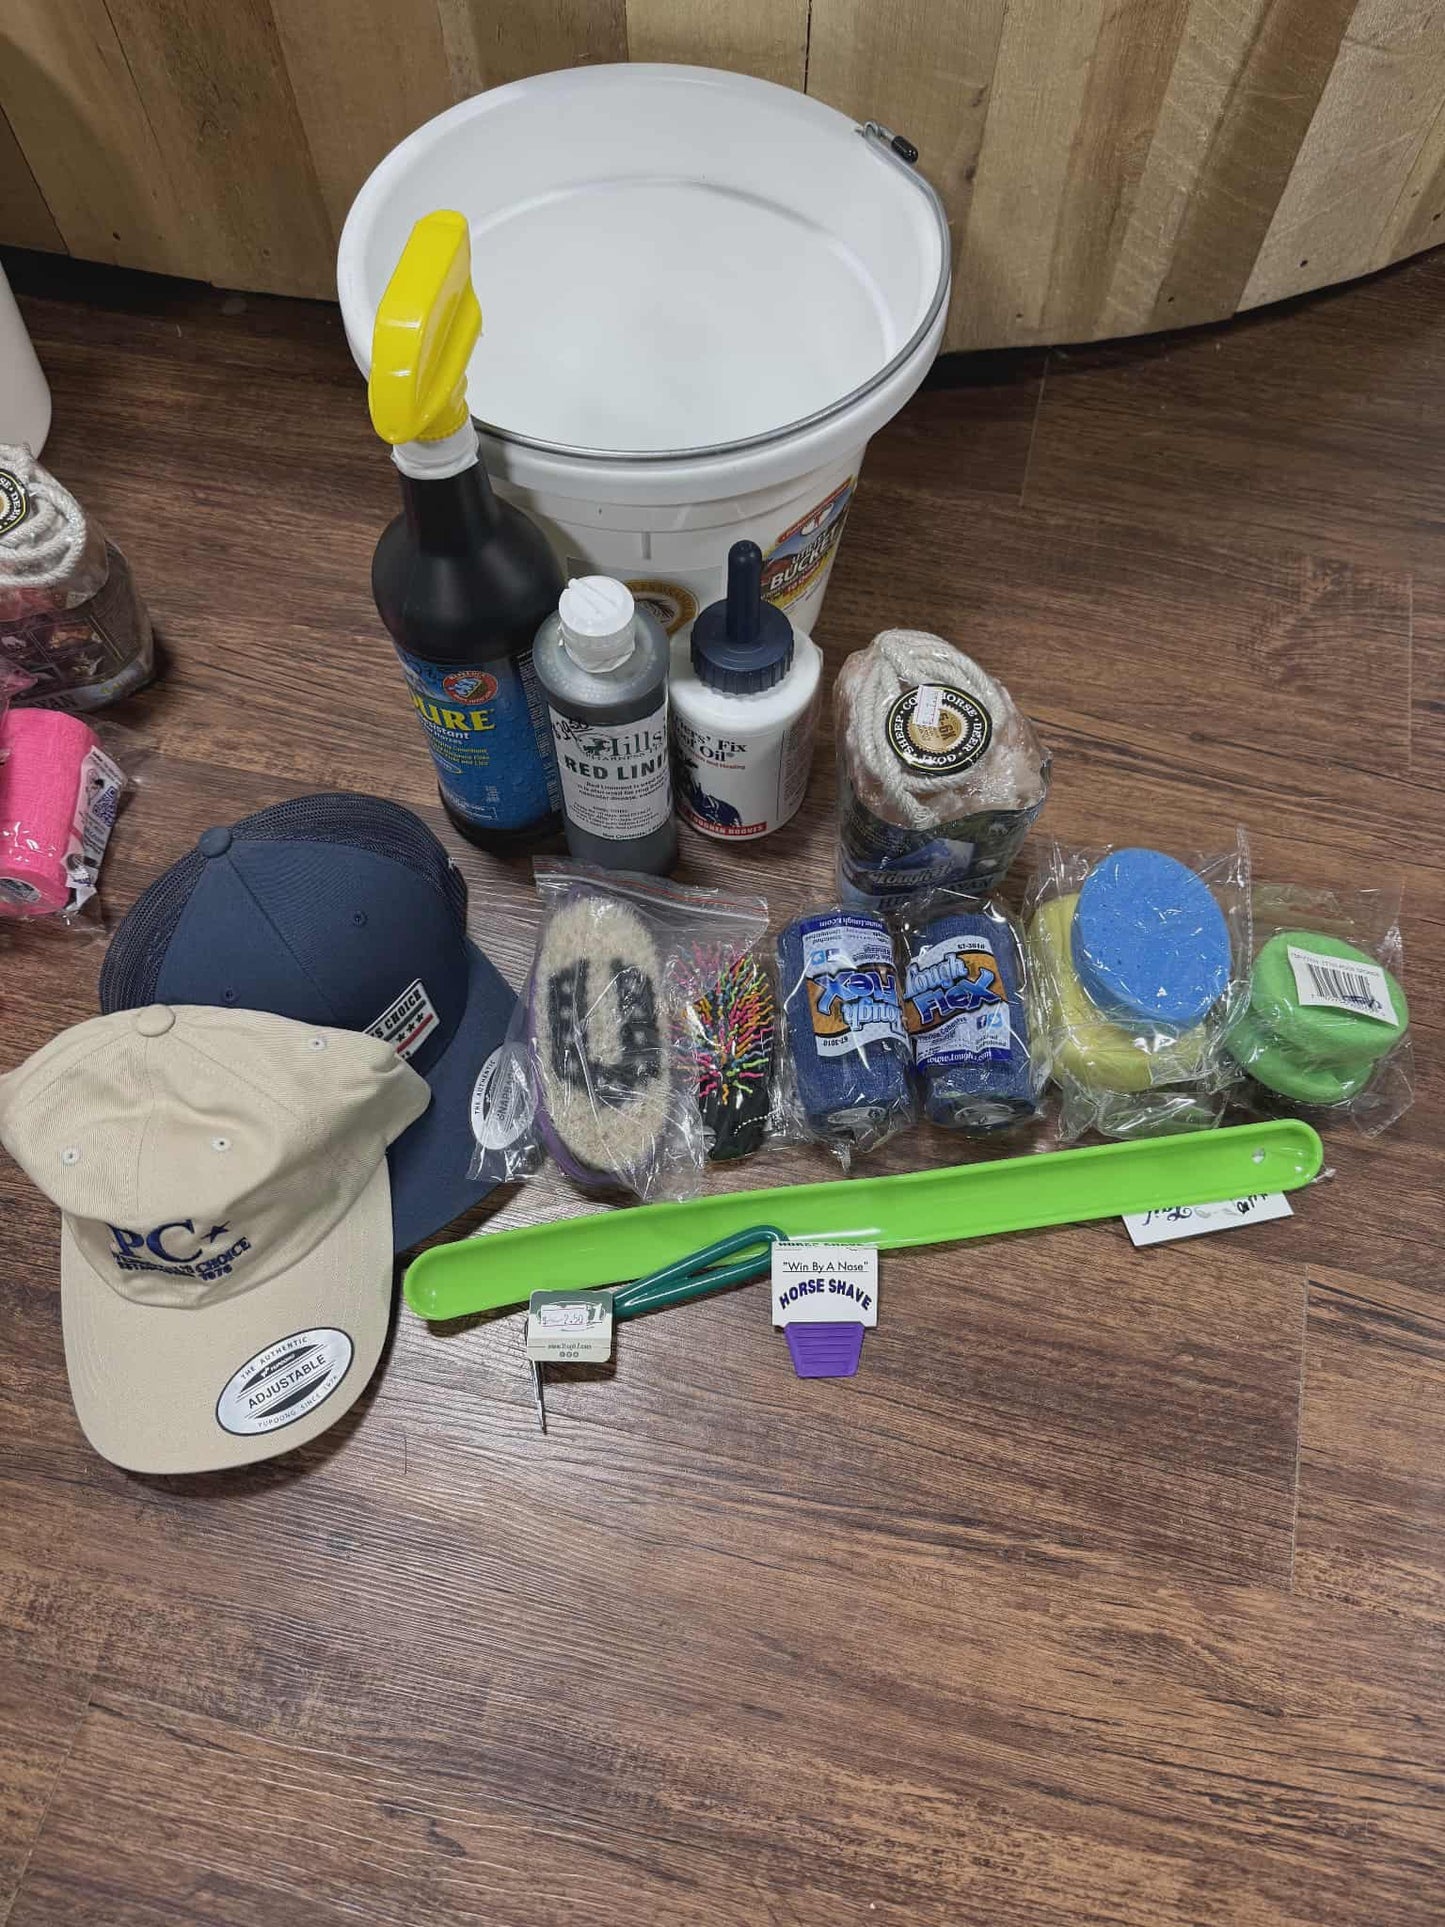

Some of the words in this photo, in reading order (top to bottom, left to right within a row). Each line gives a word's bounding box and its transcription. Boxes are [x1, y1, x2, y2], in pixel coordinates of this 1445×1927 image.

[718, 740, 748, 752] Fix
[894, 715, 914, 753] SHEEP
[962, 723, 982, 752] DEER
[564, 755, 608, 780] RED
[811, 970, 897, 1016] Flex
[904, 953, 968, 999] Tough
[384, 988, 422, 1030] CHOICE
[913, 968, 1002, 1025] Flex
[842, 1000, 911, 1037] Tough
[477, 1059, 496, 1097] AUTHENTIC
[105, 1219, 204, 1263] PC
[195, 1237, 252, 1273] CHOICE
[812, 1261, 824, 1274] By
[826, 1261, 837, 1271] A
[779, 1278, 825, 1310] HORSE
[828, 1278, 872, 1311] SHAVE
[240, 1366, 257, 1380] THE
[260, 1336, 308, 1365] AUTHENTIC
[247, 1354, 326, 1409] ADJUSTABLE
[300, 1393, 320, 1410] SINCE
